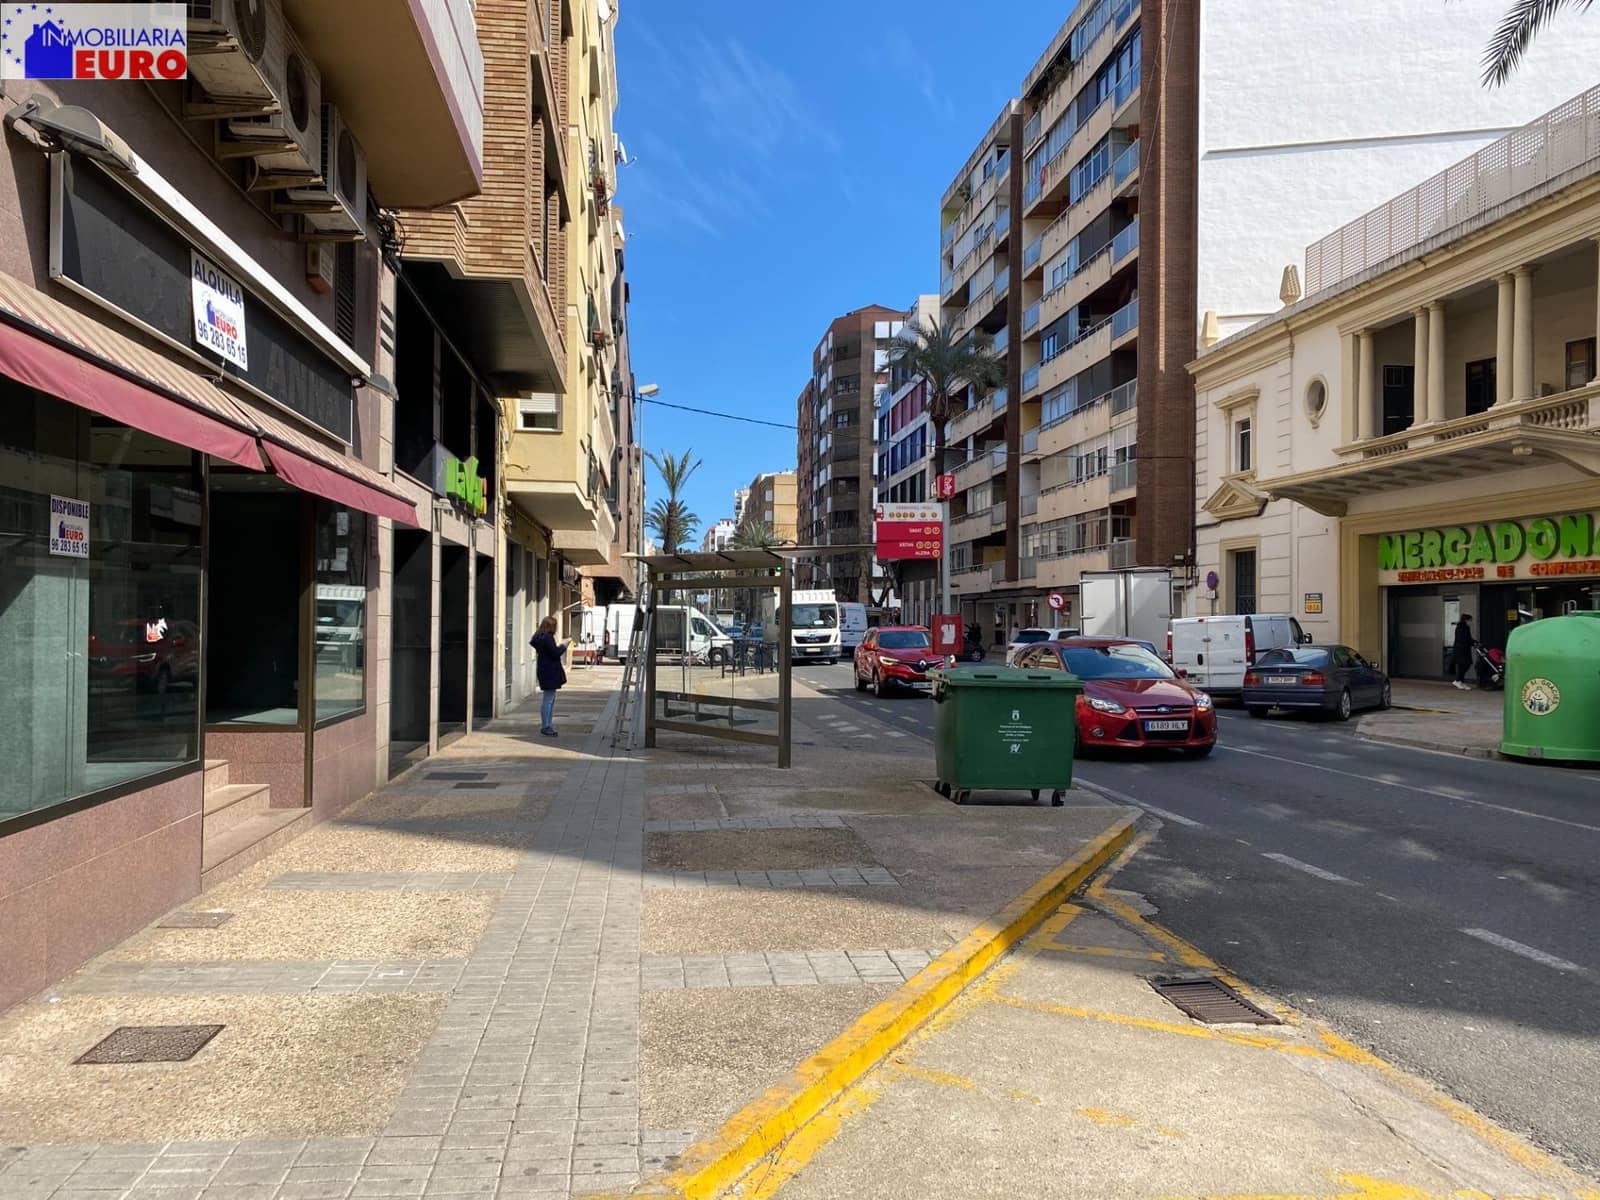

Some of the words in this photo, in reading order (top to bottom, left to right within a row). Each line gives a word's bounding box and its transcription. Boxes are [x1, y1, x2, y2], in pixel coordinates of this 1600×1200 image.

[194, 259, 242, 307] ALQUILA
[216, 315, 238, 340] EURO
[197, 319, 209, 341] 96
[210, 327, 226, 351] 283
[226, 337, 236, 358] 65
[237, 343, 247, 364] 15
[51, 498, 88, 519] DISPONIBLE
[51, 538, 59, 551] 96
[60, 539, 72, 553] 283
[81, 542, 88, 554] 15
[66, 529, 84, 541] EURO
